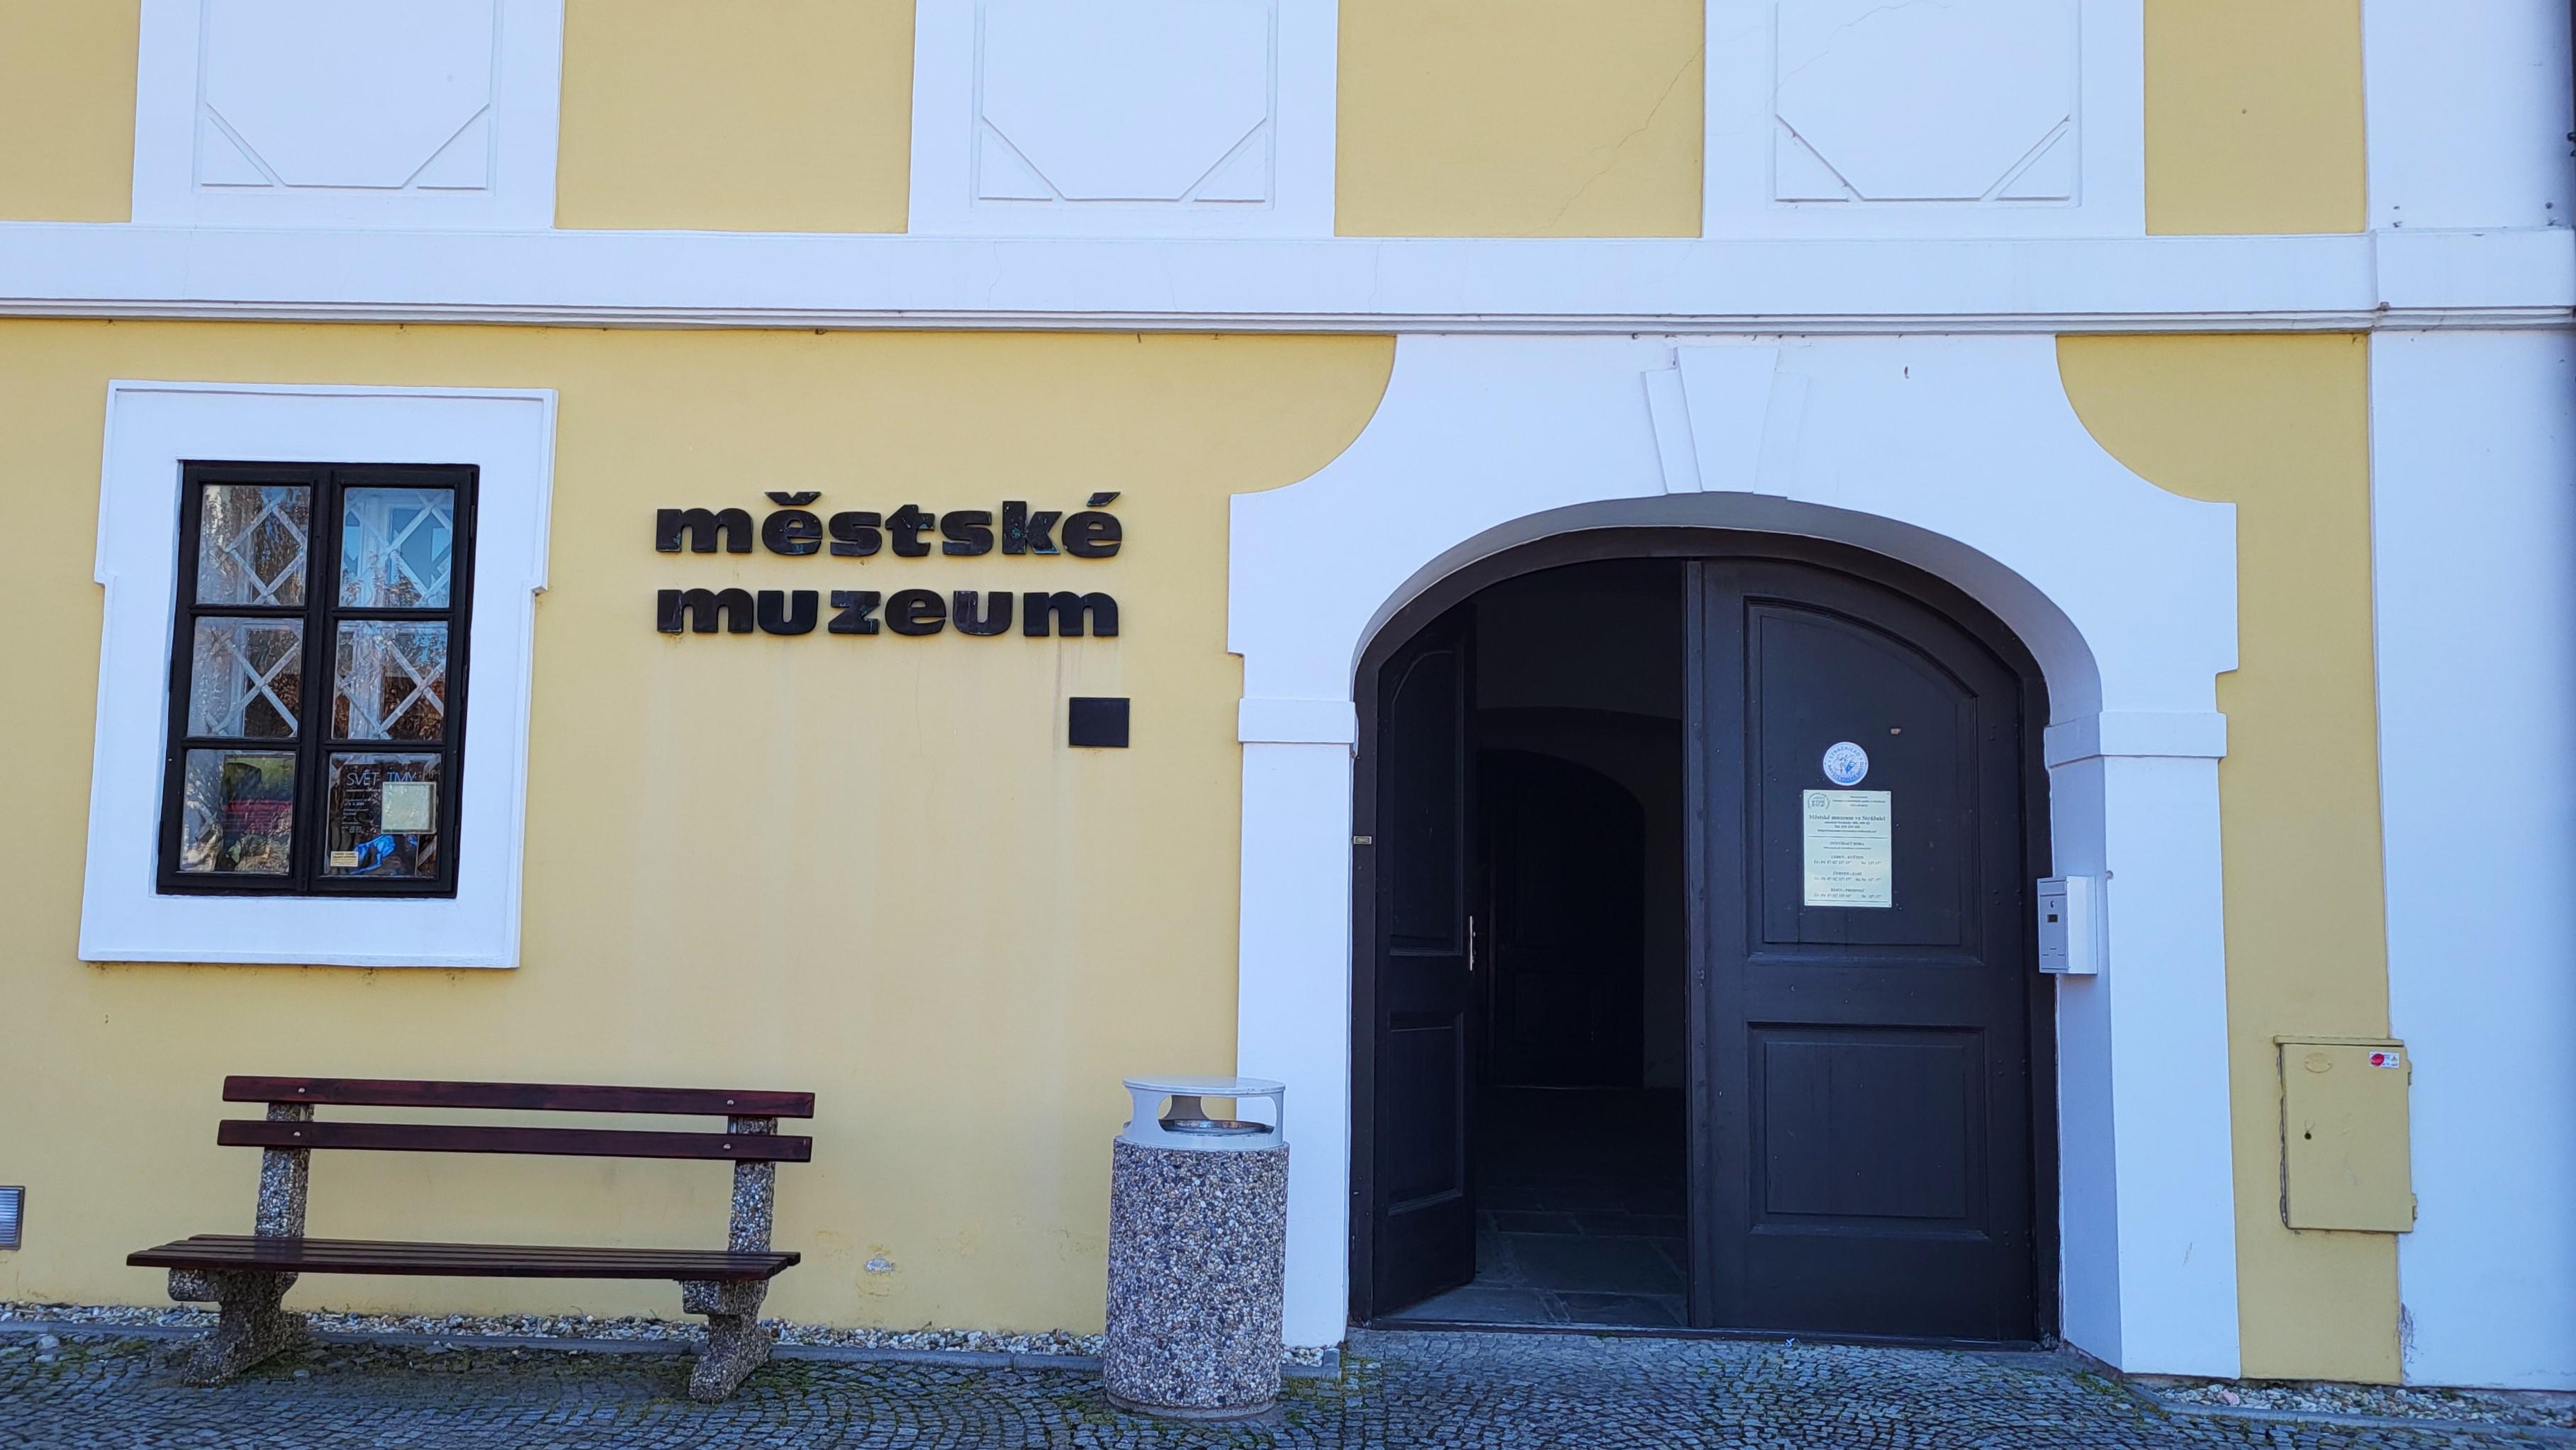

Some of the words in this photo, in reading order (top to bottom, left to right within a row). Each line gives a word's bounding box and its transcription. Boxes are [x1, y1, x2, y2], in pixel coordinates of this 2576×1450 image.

[656, 491, 1123, 558] městské
[657, 588, 1119, 636] muzeum
[346, 769, 380, 786] SVĚT
